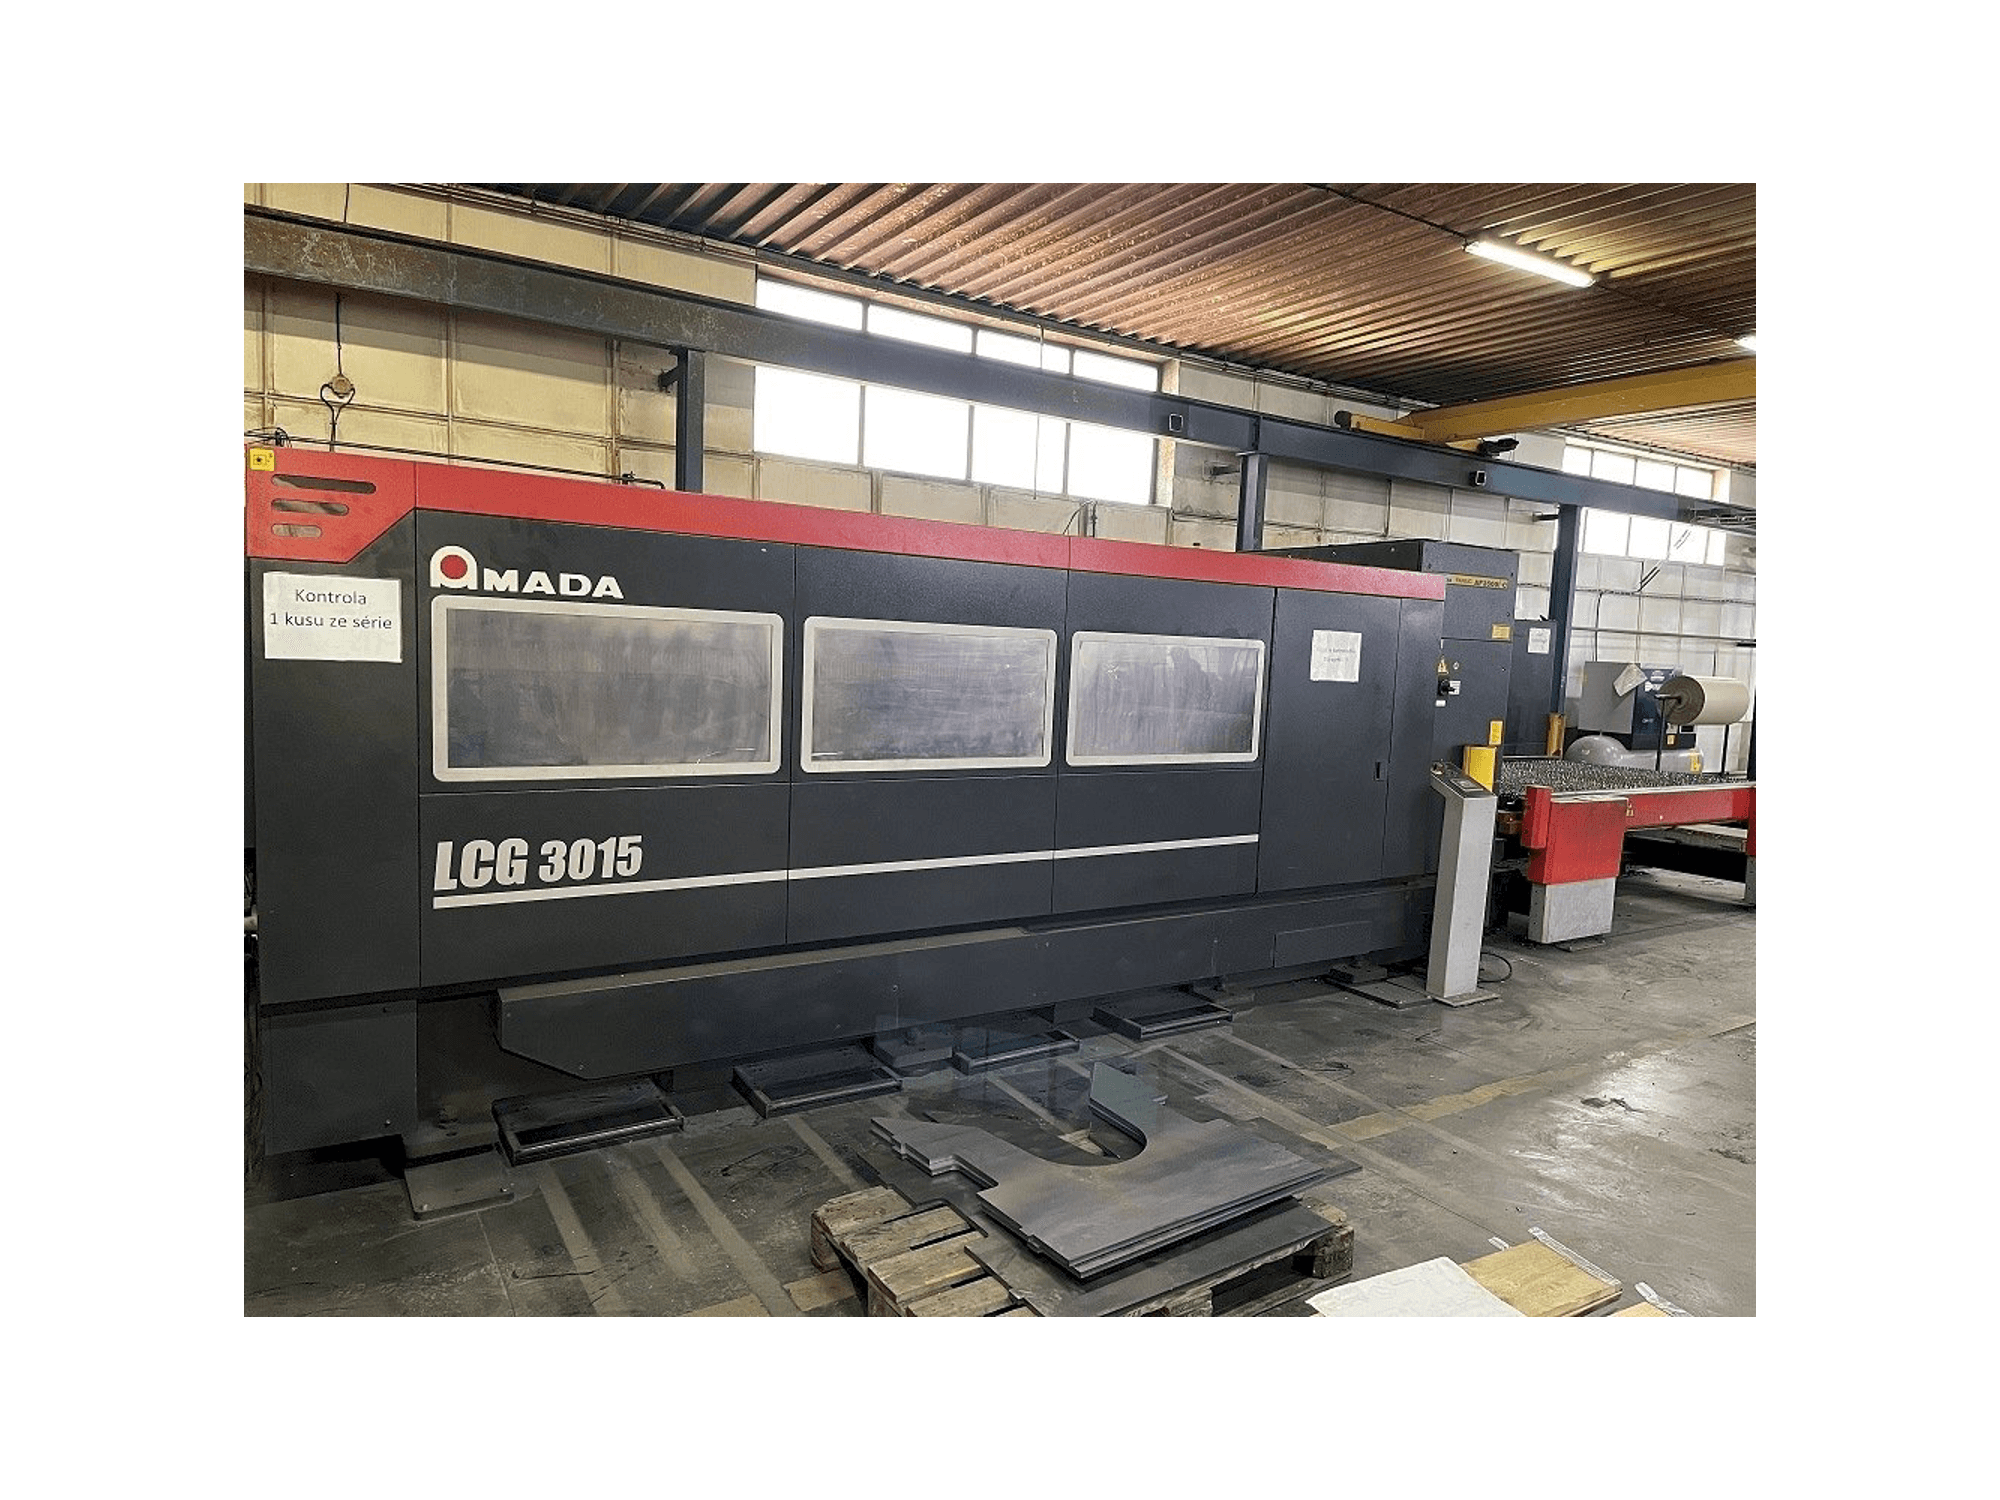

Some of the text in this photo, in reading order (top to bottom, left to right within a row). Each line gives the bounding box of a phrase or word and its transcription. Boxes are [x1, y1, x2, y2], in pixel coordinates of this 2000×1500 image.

[430, 545, 625, 599] AMADA
[295, 588, 367, 605] Kontrola
[270, 611, 392, 629] 1 kusu ze série
[434, 835, 643, 891] LCG 3015
